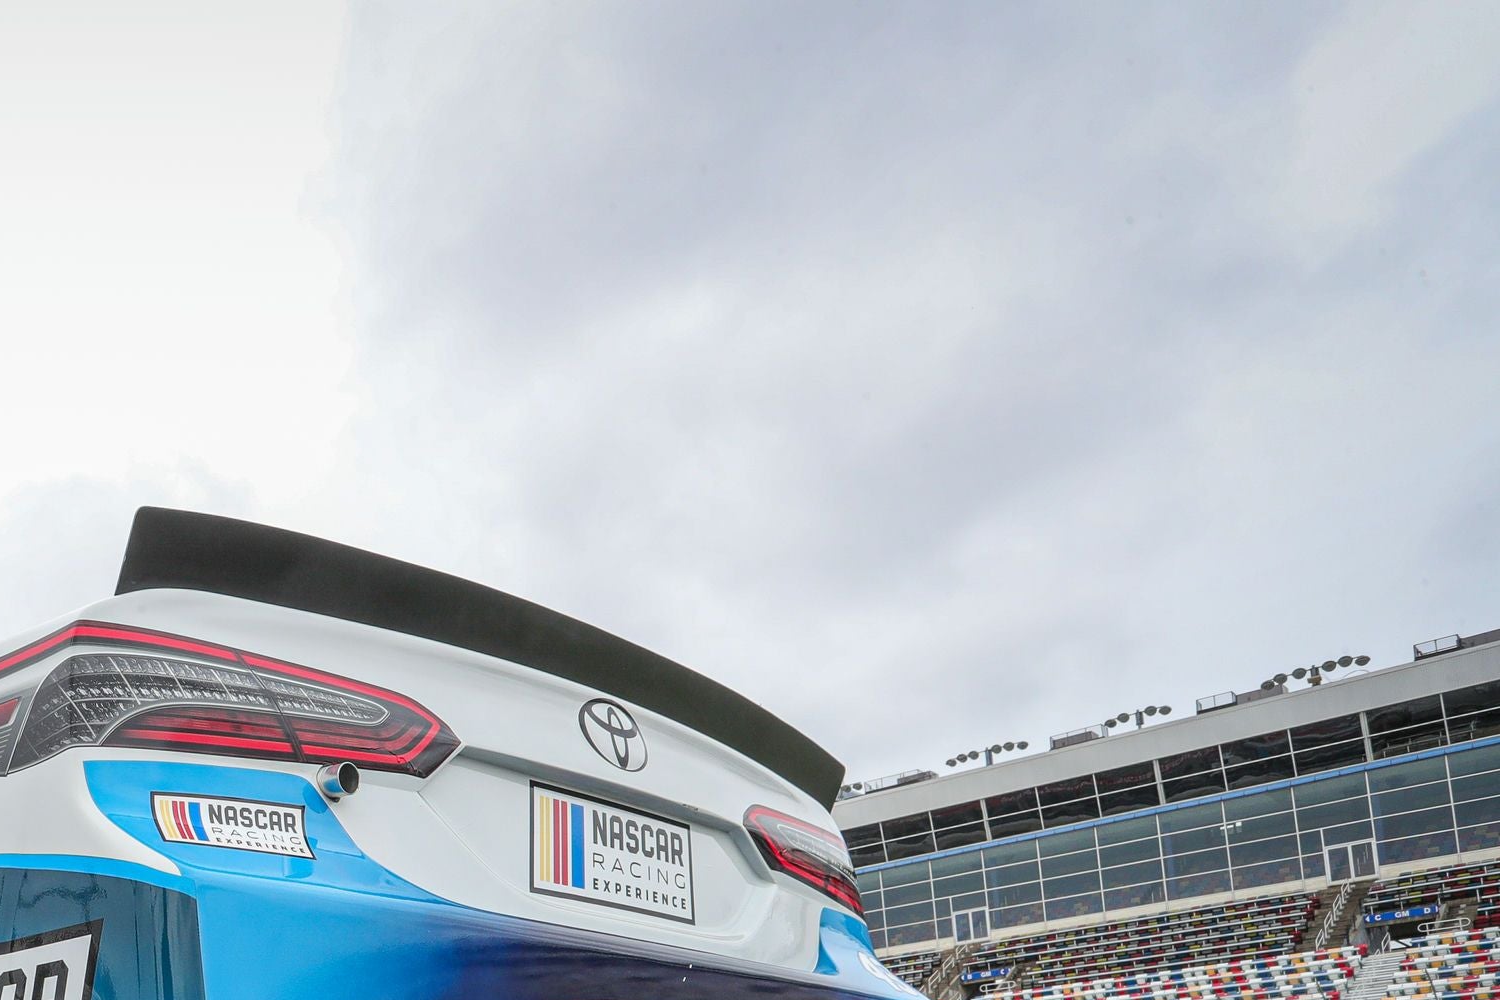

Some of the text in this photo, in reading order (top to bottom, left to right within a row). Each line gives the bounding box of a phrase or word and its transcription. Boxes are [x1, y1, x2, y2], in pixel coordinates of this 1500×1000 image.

[207, 803, 298, 834] NASCAR
[211, 826, 302, 846] RACING
[216, 837, 306, 854] EXPERIENCE
[592, 809, 685, 867] NASCAR
[592, 852, 687, 890] RACING
[593, 878, 688, 910] EXPERIENCE
[1394, 910, 1410, 918] GM
